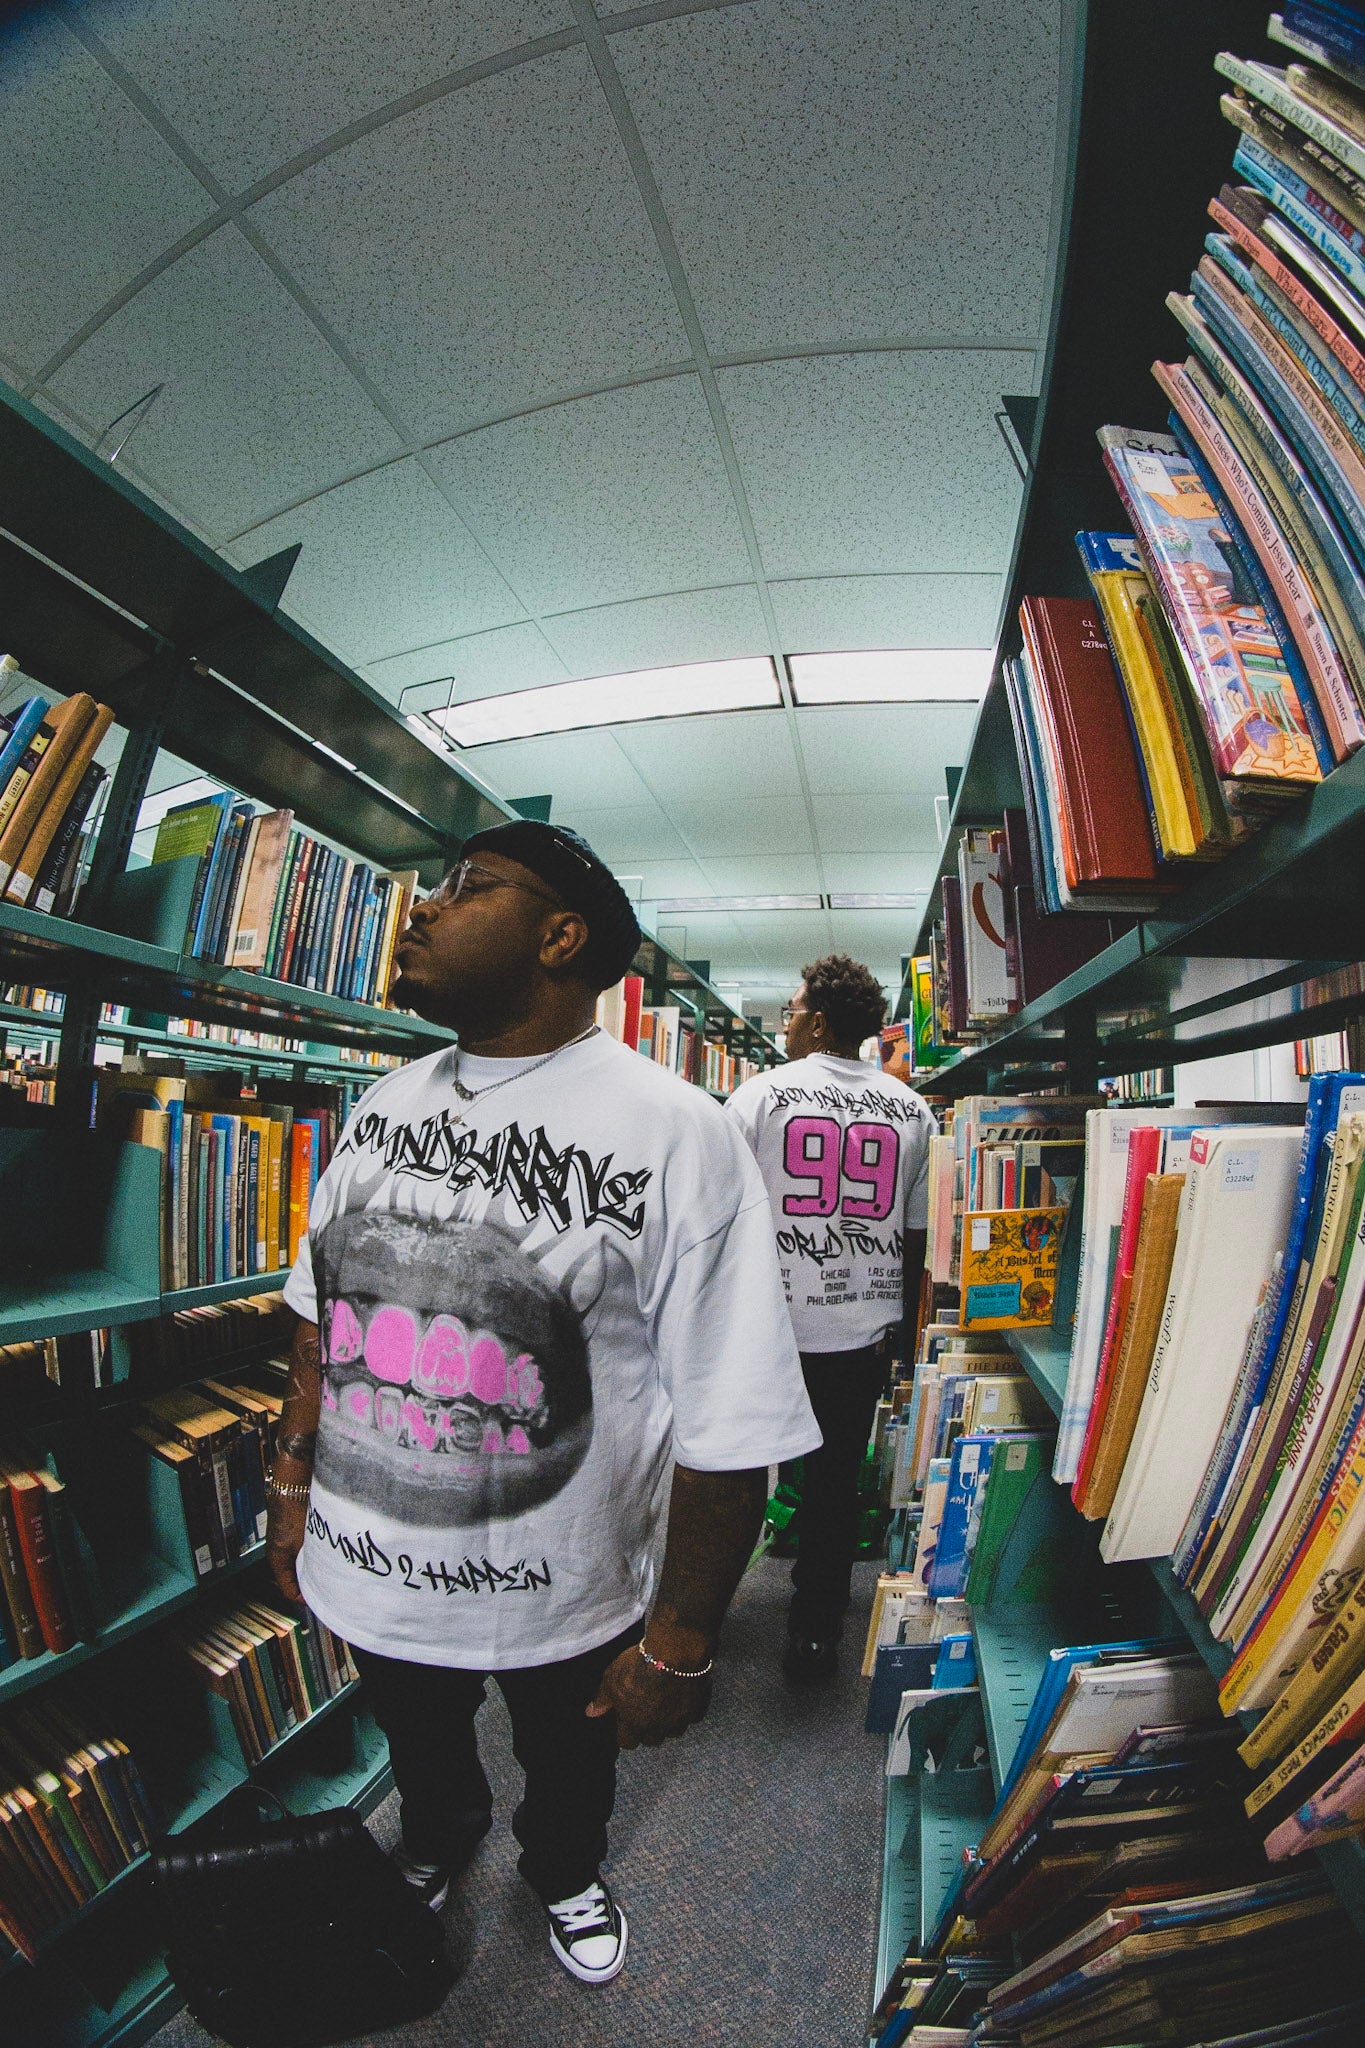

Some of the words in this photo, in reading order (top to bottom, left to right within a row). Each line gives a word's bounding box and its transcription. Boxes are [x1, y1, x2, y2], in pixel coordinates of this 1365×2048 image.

[1273, 192, 1321, 239] Frozen
[1312, 230, 1359, 276] Noses
[1275, 265, 1298, 298] What
[1272, 317, 1309, 356] Count
[1325, 387, 1359, 423] Jesse
[1123, 502, 1146, 539] Mama
[1142, 548, 1163, 582] Papa
[1213, 432, 1231, 462] Guess
[1230, 459, 1249, 495] Who's
[1246, 492, 1271, 541] Coming,
[1267, 538, 1287, 570] Jesse
[1284, 568, 1302, 601] Bear
[1312, 632, 1328, 665] Simon
[1324, 664, 1334, 677] &
[1329, 675, 1349, 723] Schuster
[1150, 810, 1160, 849] VIKING
[45, 845, 68, 895] willy-nilly
[284, 861, 301, 917] BLACKWATER
[292, 881, 306, 916] BUFFALO
[318, 891, 330, 919] Coyote
[279, 917, 289, 950] SWAMP
[289, 917, 299, 933] GAL
[250, 1138, 258, 1159] CAGED
[1297, 1109, 1314, 1176] CARTER
[249, 1162, 258, 1184] EAGLES
[782, 1115, 900, 1222] 99
[1187, 1170, 1199, 1212] CARTER
[1320, 1138, 1345, 1249] CARTWRIGHT
[776, 1223, 843, 1267] ORLD
[1005, 1251, 1042, 1270] Bushel
[820, 1268, 851, 1281] CHICAGO
[824, 1281, 847, 1293] MIAMI
[867, 1267, 885, 1278] LAS
[870, 1279, 903, 1290] HOUSTO
[806, 1292, 858, 1307] PHILADELPHIA
[1160, 1293, 1177, 1342] woof!
[1284, 1283, 1304, 1338] MICHELLE
[1150, 1343, 1166, 1394] woof!
[1265, 1338, 1288, 1402] CARTLIDGE
[1300, 1367, 1320, 1404] THE
[1303, 1380, 1325, 1425] DEAR
[1275, 1404, 1308, 1475] COUSINS
[1287, 1423, 1308, 1471] ANNIE
[1327, 1468, 1364, 1541] TWICE
[398, 1554, 417, 1590] 2
[417, 1556, 553, 1596] HAPPEN
